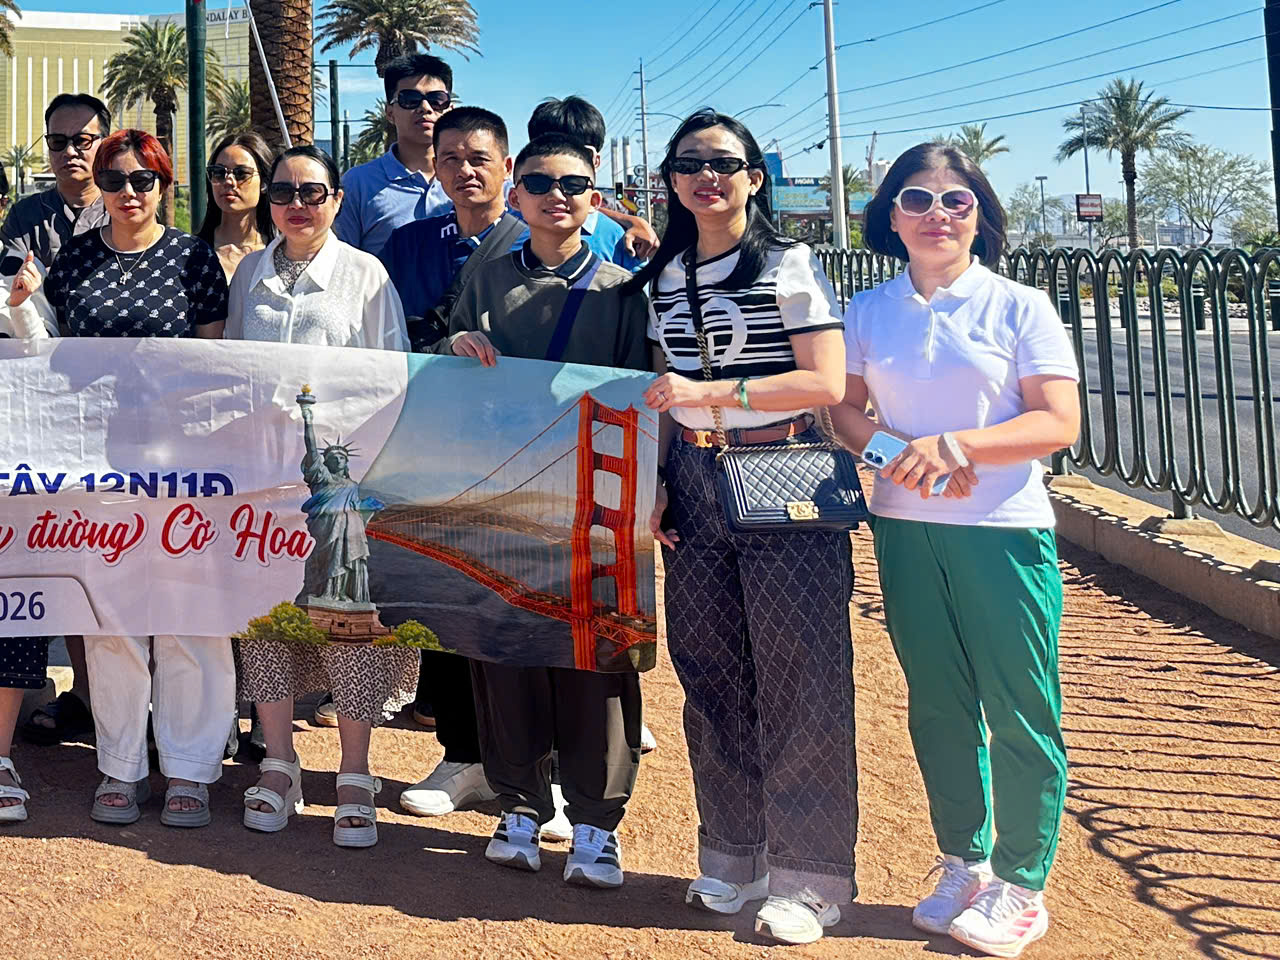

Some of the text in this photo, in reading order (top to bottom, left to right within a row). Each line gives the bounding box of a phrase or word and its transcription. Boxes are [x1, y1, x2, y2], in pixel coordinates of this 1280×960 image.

[80, 472, 234, 498] 12N11Đ
[27, 510, 144, 563] đường
[161, 503, 218, 555] Cờ
[229, 503, 313, 563] Hoa
